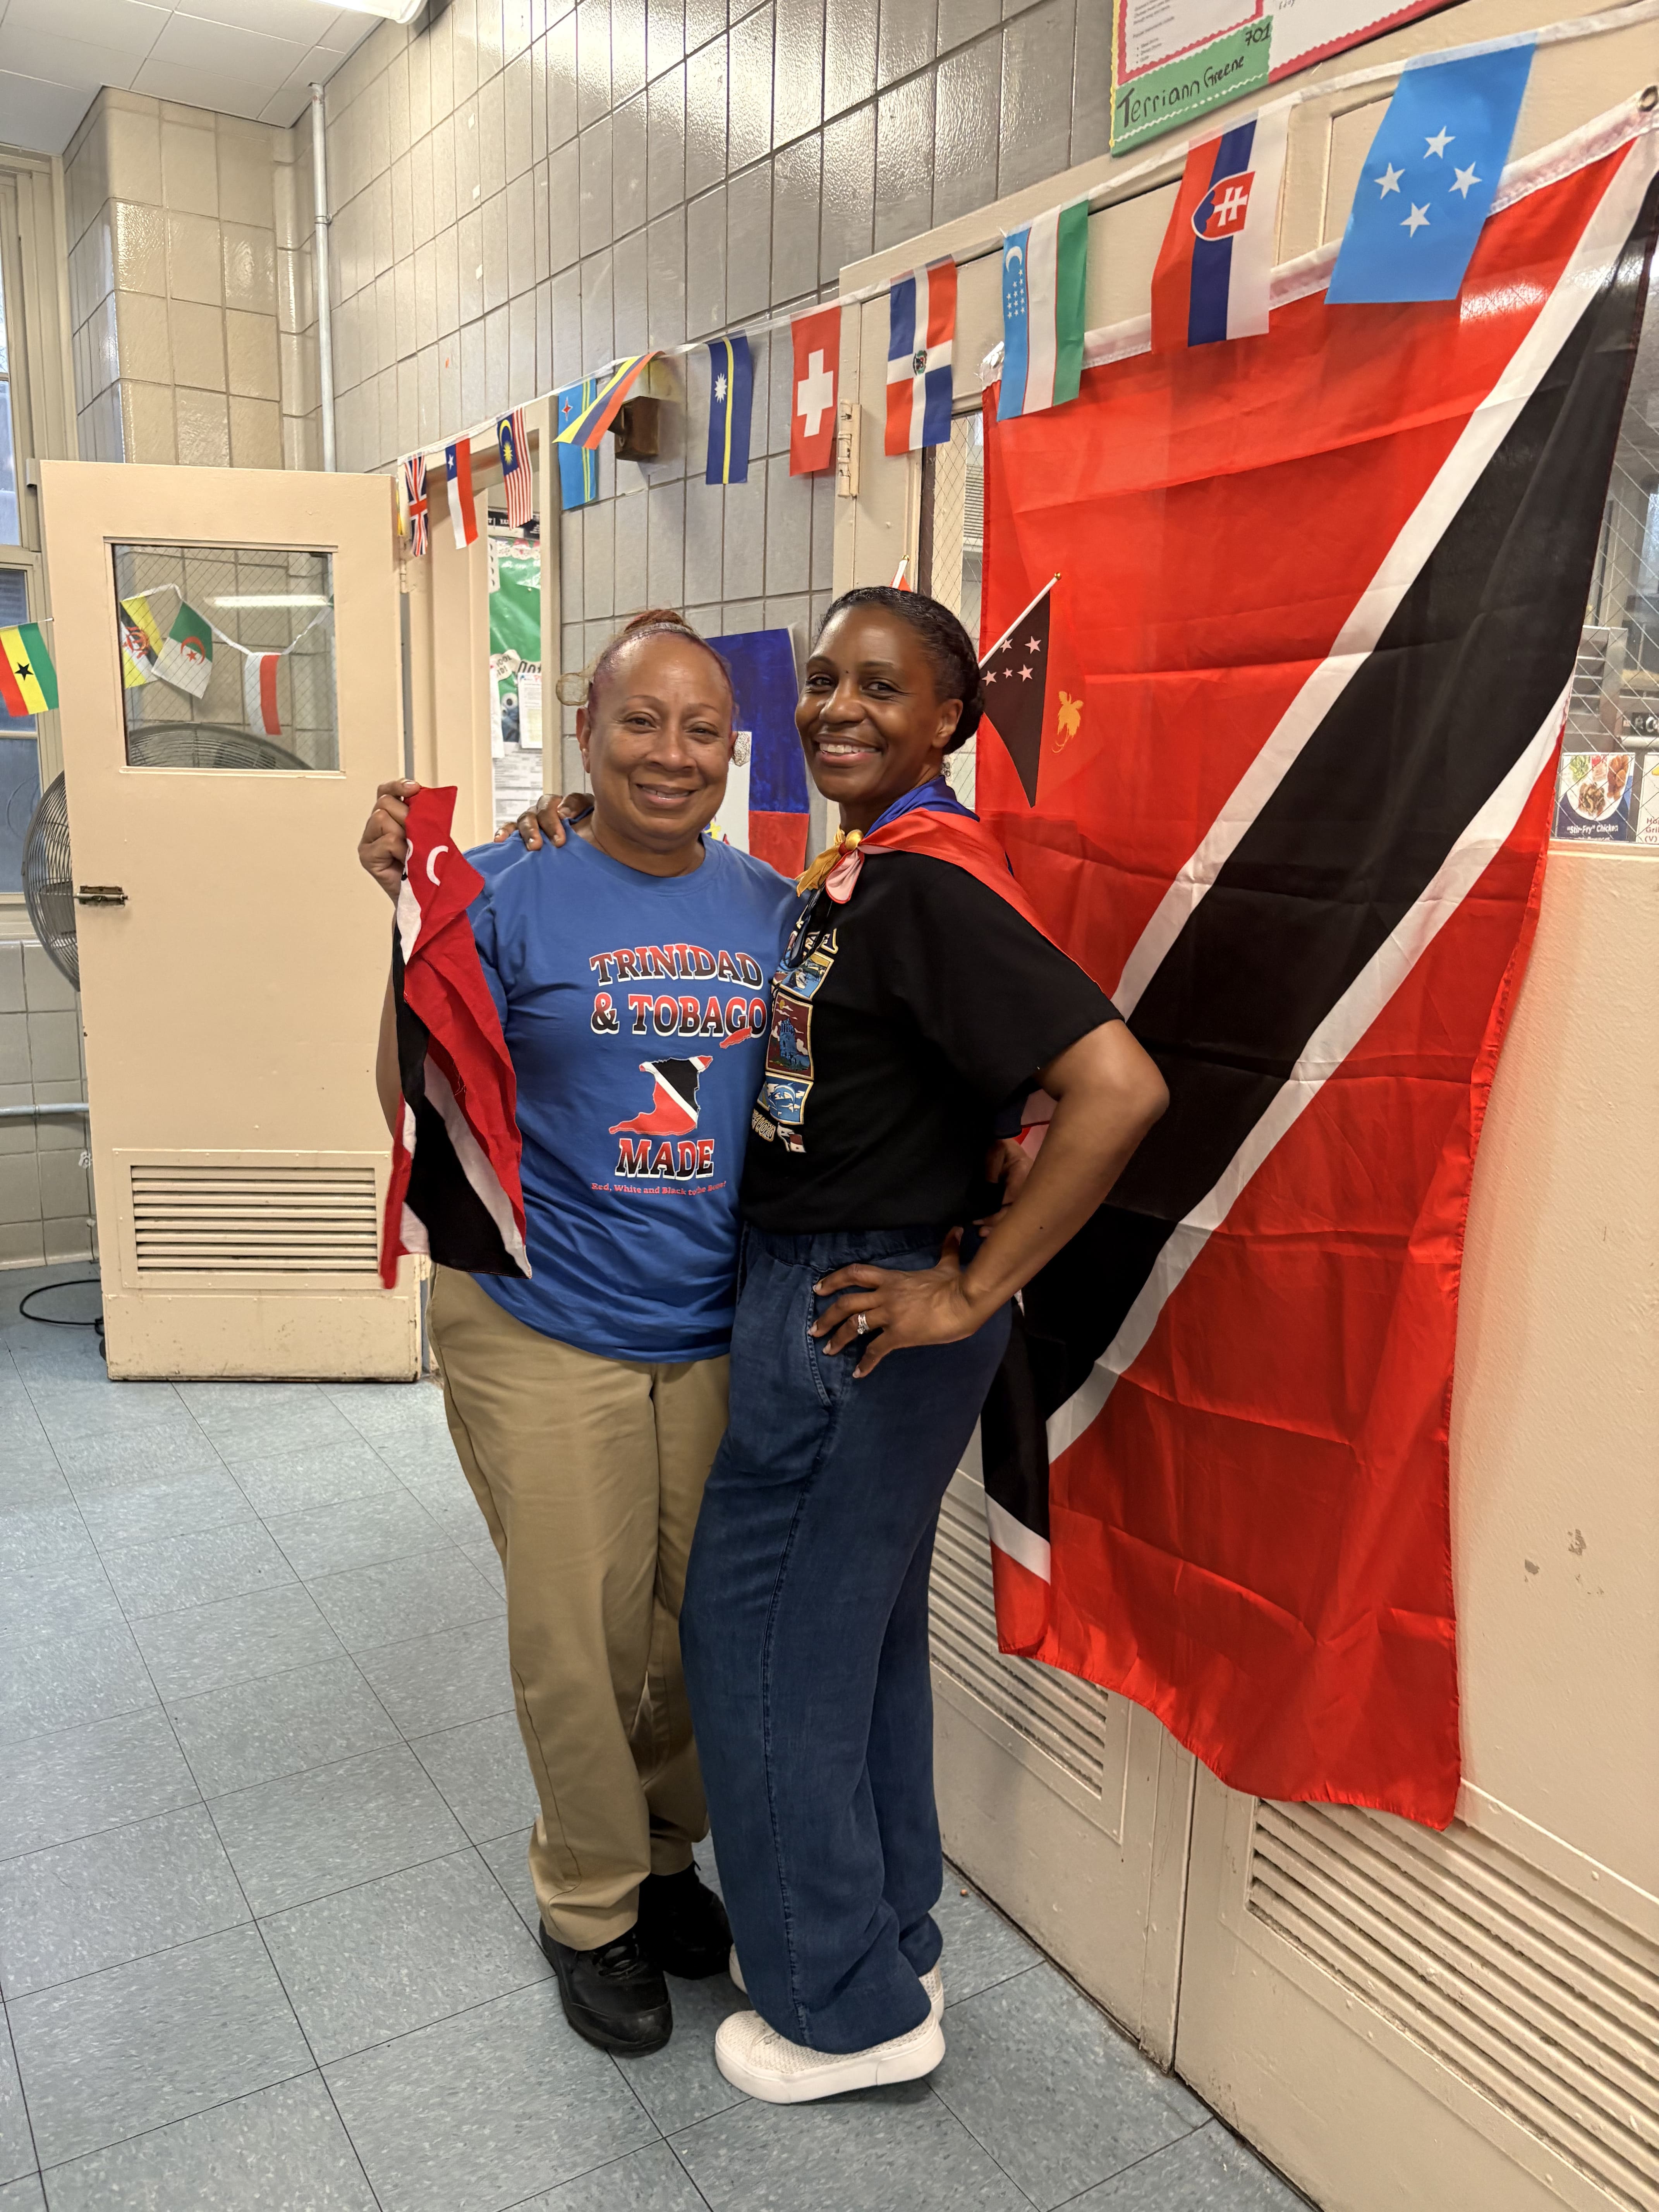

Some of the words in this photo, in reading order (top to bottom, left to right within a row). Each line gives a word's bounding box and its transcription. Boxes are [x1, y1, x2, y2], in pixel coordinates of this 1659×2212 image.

[1245, 22, 1271, 46] 701
[1117, 80, 1200, 128] Terriann
[1204, 55, 1244, 88] Greene
[1596, 824, 1619, 833] Chicken
[589, 943, 763, 990] TRINIDAD
[590, 992, 619, 1034] &
[628, 994, 767, 1038] TOBAGO
[615, 1138, 714, 1180] MADE
[591, 1183, 611, 1192] Red,
[614, 1184, 641, 1193] White
[662, 1187, 686, 1195] Black
